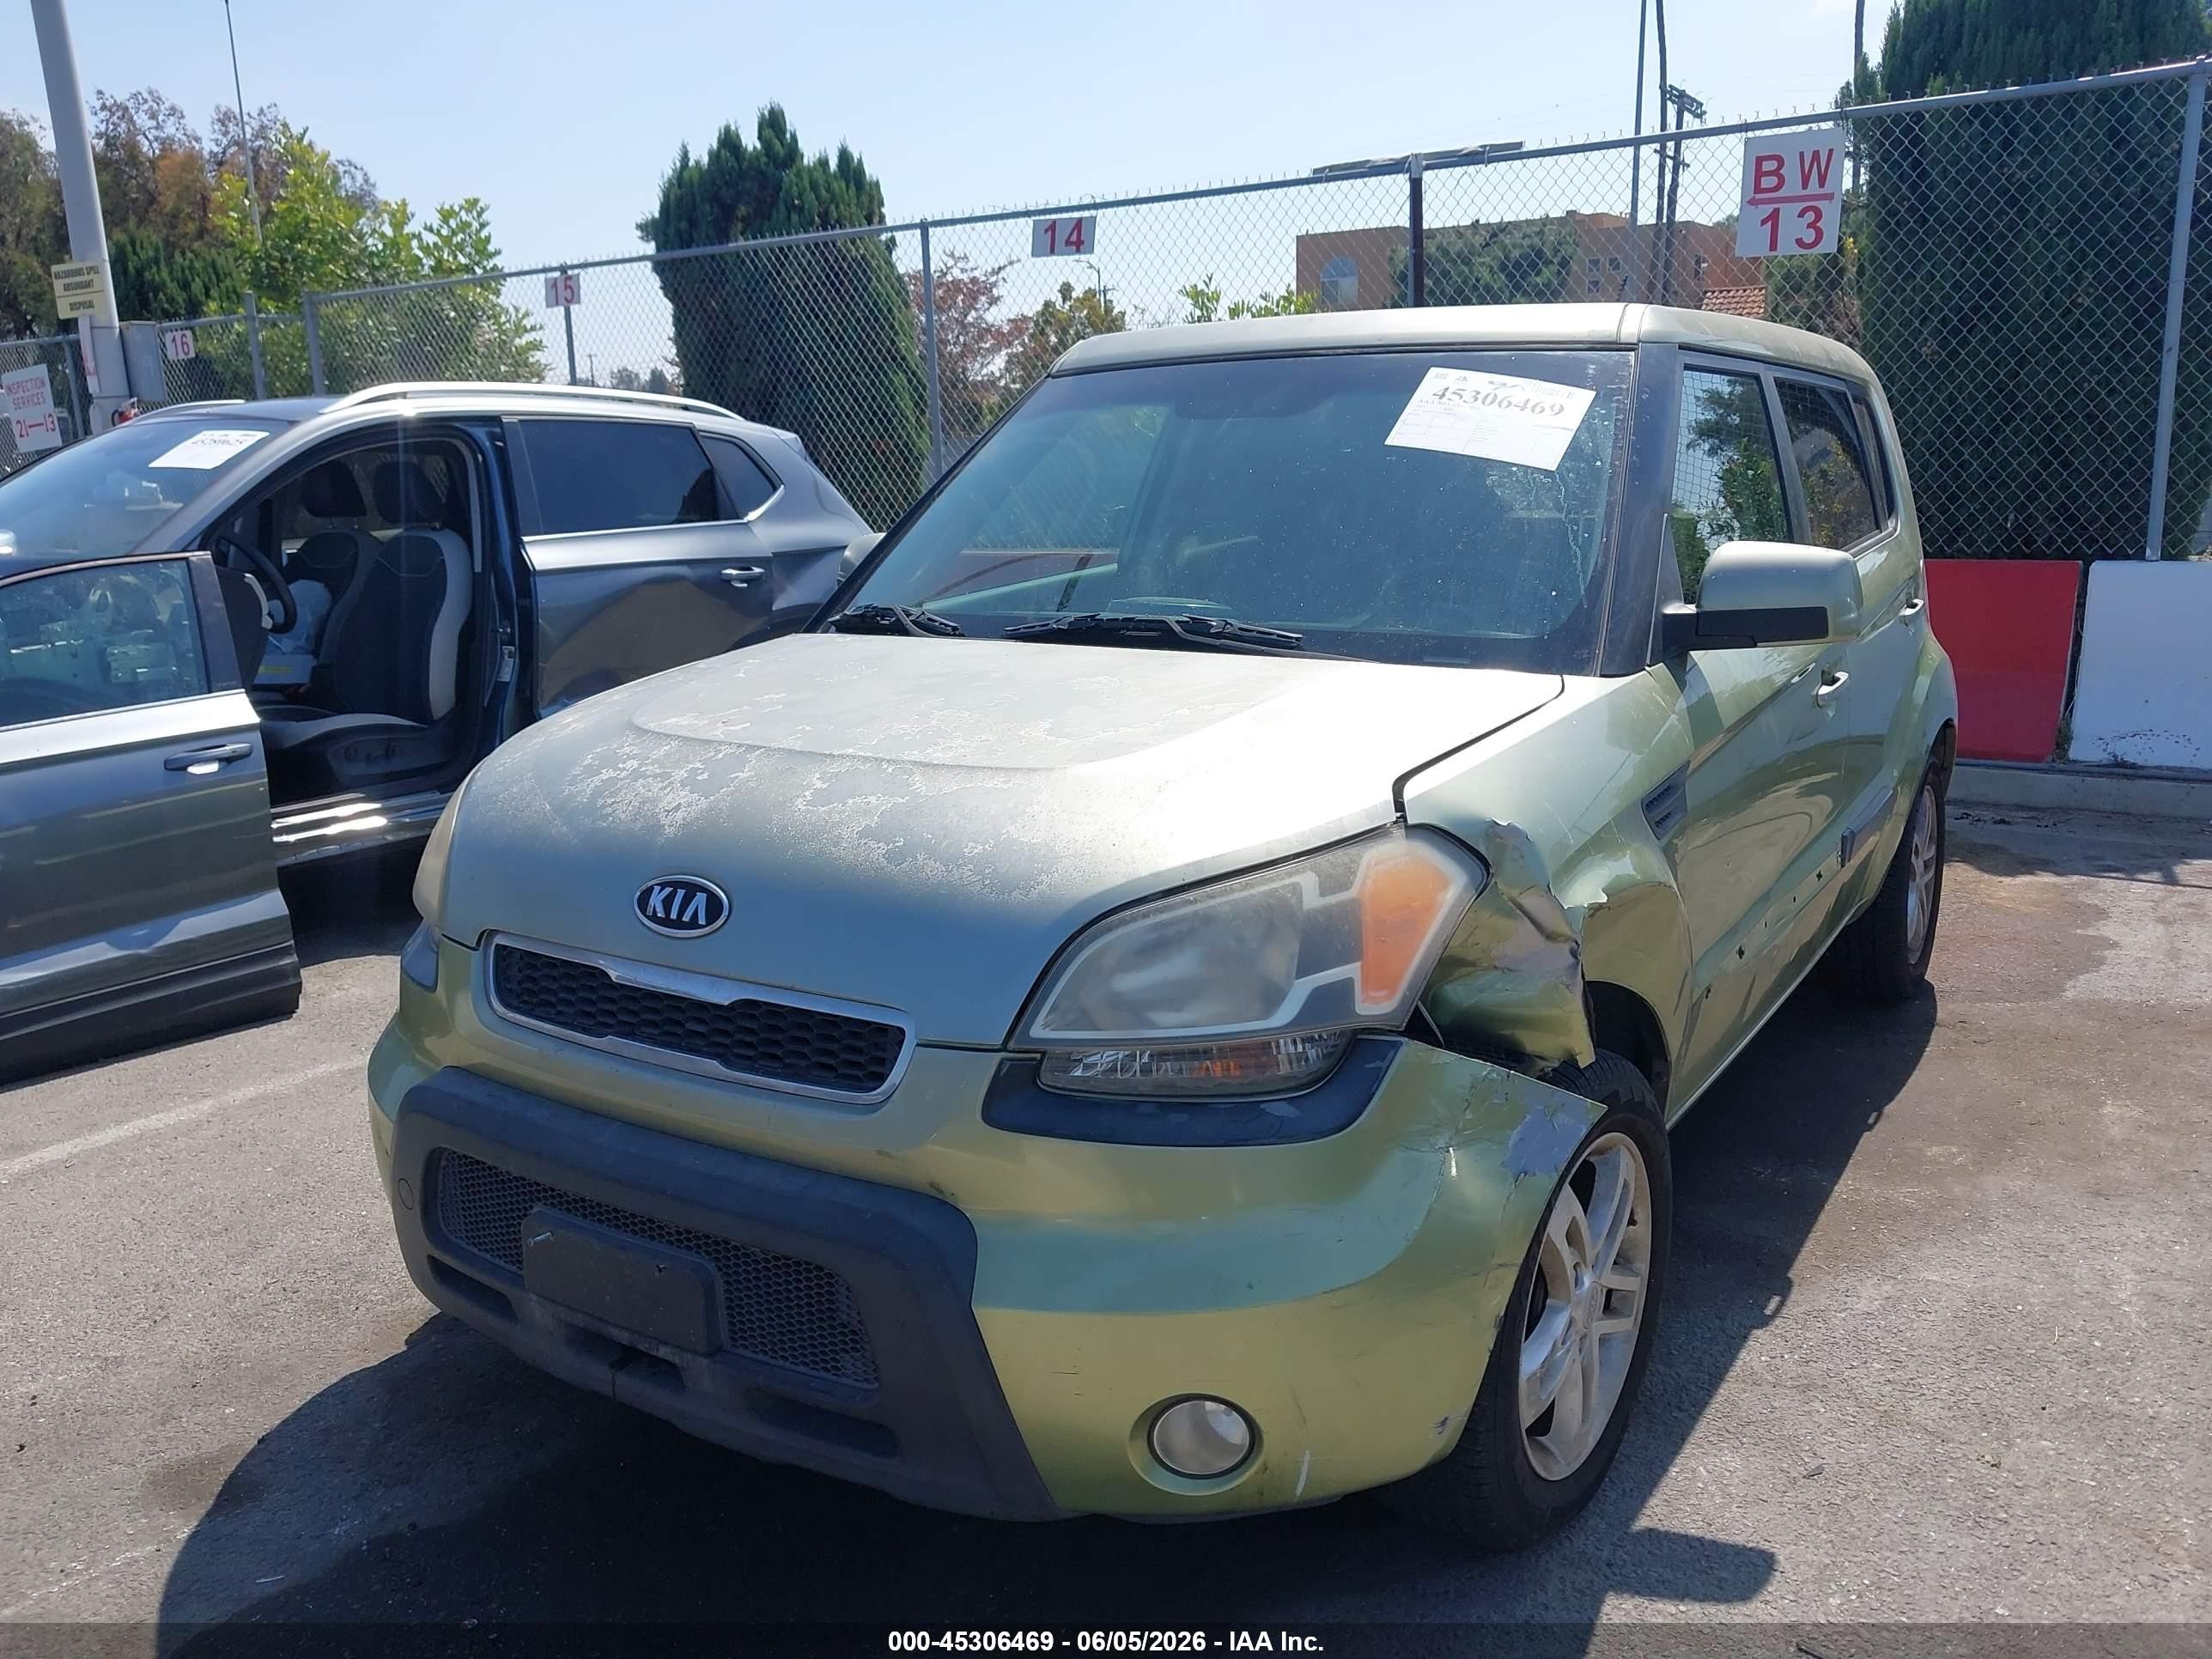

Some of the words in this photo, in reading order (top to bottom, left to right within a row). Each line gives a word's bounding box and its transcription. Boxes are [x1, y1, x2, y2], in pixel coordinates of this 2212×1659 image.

[1043, 218, 1085, 255] 14
[1759, 204, 1825, 252] 13
[85, 264, 100, 276] SPILL
[550, 275, 574, 306] 15
[69, 300, 95, 312] DISPOSAL
[171, 332, 191, 357] 16
[5, 377, 46, 395] INSPECTION
[13, 392, 46, 410] SERVICES
[1432, 386, 1565, 417] 45306469
[646, 885, 708, 926] KIA
